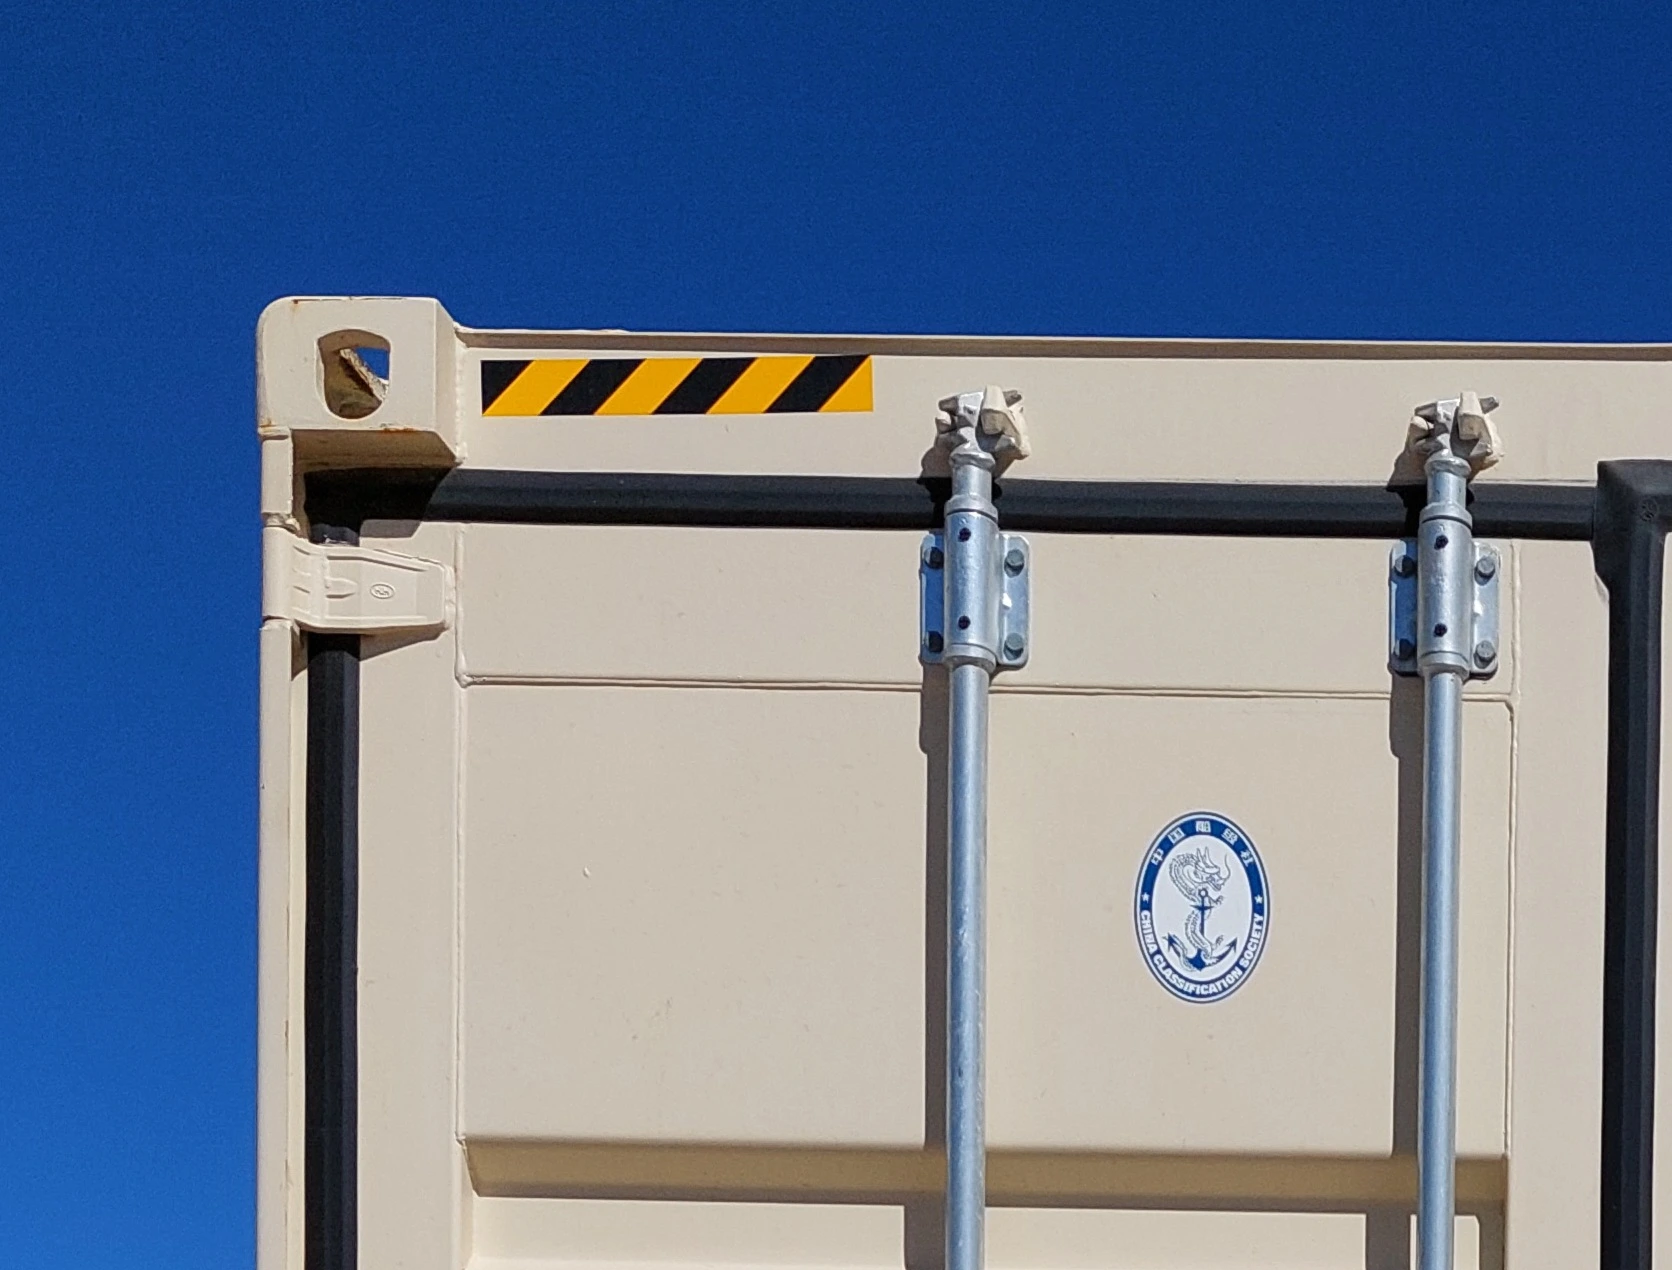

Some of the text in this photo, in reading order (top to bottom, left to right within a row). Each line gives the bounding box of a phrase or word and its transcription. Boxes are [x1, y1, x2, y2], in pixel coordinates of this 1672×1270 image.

[1140, 910, 1264, 996] CHINA CLASSIFICATION SOCIETY
